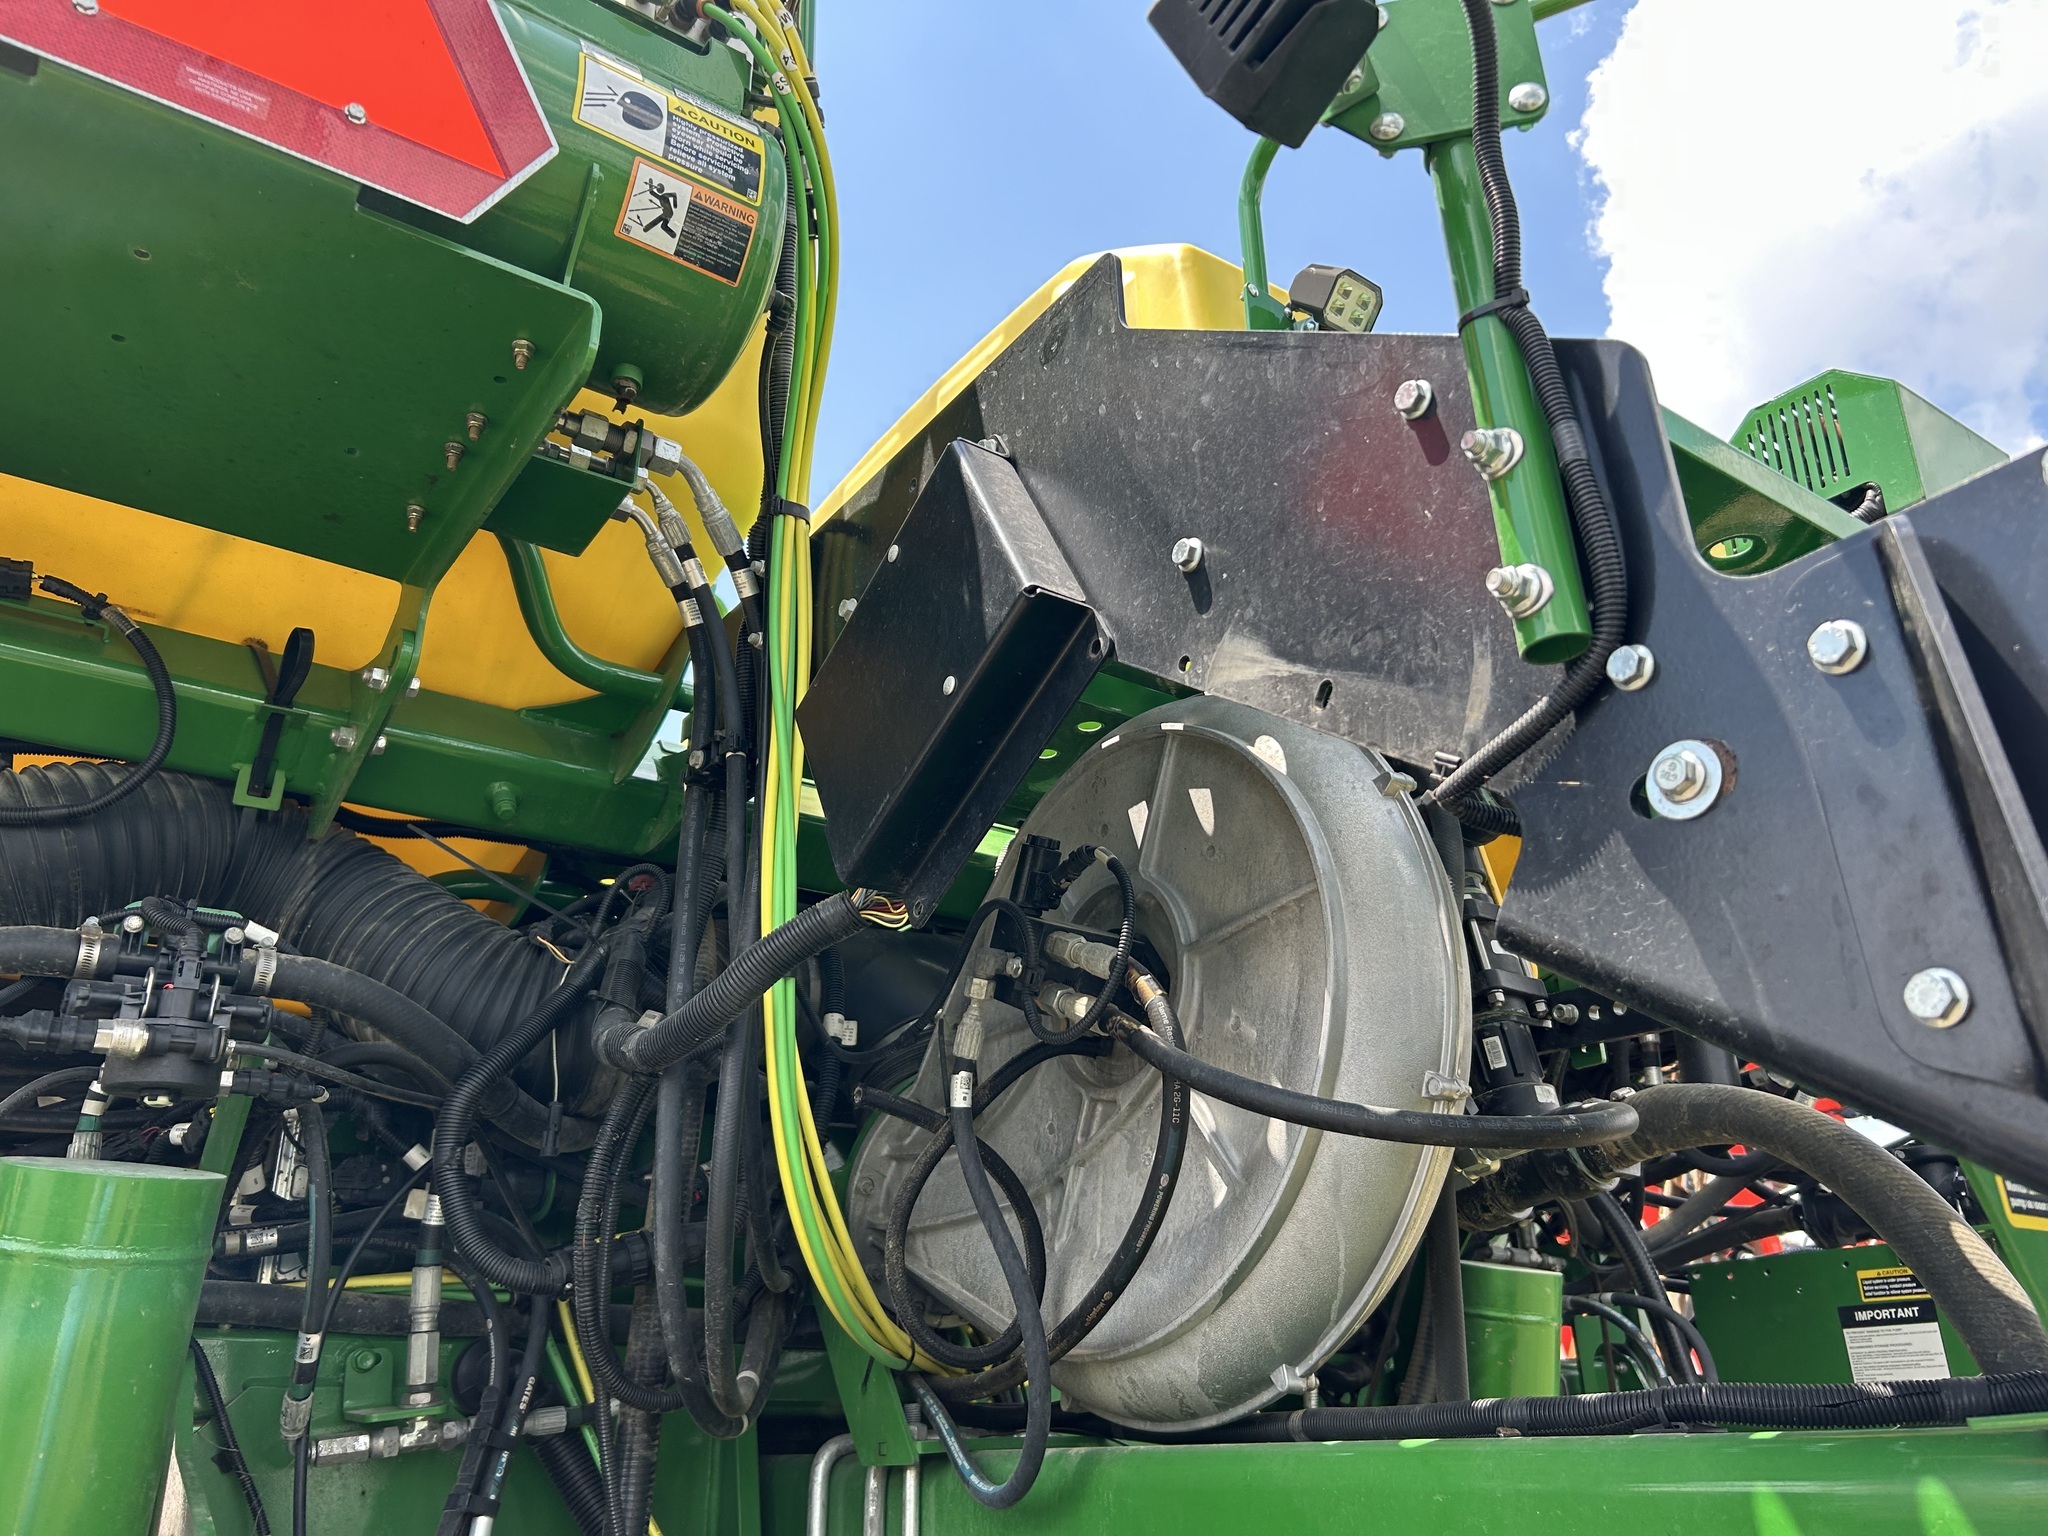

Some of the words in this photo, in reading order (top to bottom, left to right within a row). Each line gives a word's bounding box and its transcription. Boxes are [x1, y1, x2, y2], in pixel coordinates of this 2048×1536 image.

[775, 76, 788, 91] S3
[673, 115, 697, 131] Highly
[699, 129, 743, 152] pressurized
[688, 111, 754, 147] CAUTION
[671, 133, 690, 146] worn
[693, 144, 713, 156] while
[715, 154, 750, 175] servicing.
[671, 139, 696, 155] Before
[698, 153, 733, 174] servicing
[672, 128, 703, 145] eyewear
[706, 143, 731, 158] should
[734, 156, 742, 164] be
[706, 137, 744, 158] Protective
[668, 153, 703, 173] pressure
[669, 146, 695, 162] relieve
[708, 165, 735, 181] system
[704, 194, 755, 225] WARNING
[1155, 1001, 1169, 1024] Flame
[1172, 1092, 1180, 1123] 2G-11C
[1448, 1118, 1472, 1129] 212F
[1478, 1119, 1509, 1130] Meets
[1514, 1120, 1533, 1130] ISO
[1149, 1191, 1163, 1220] POWERING
[1854, 1306, 1919, 1322] IMPORTANT
[519, 1376, 536, 1410] GATES
